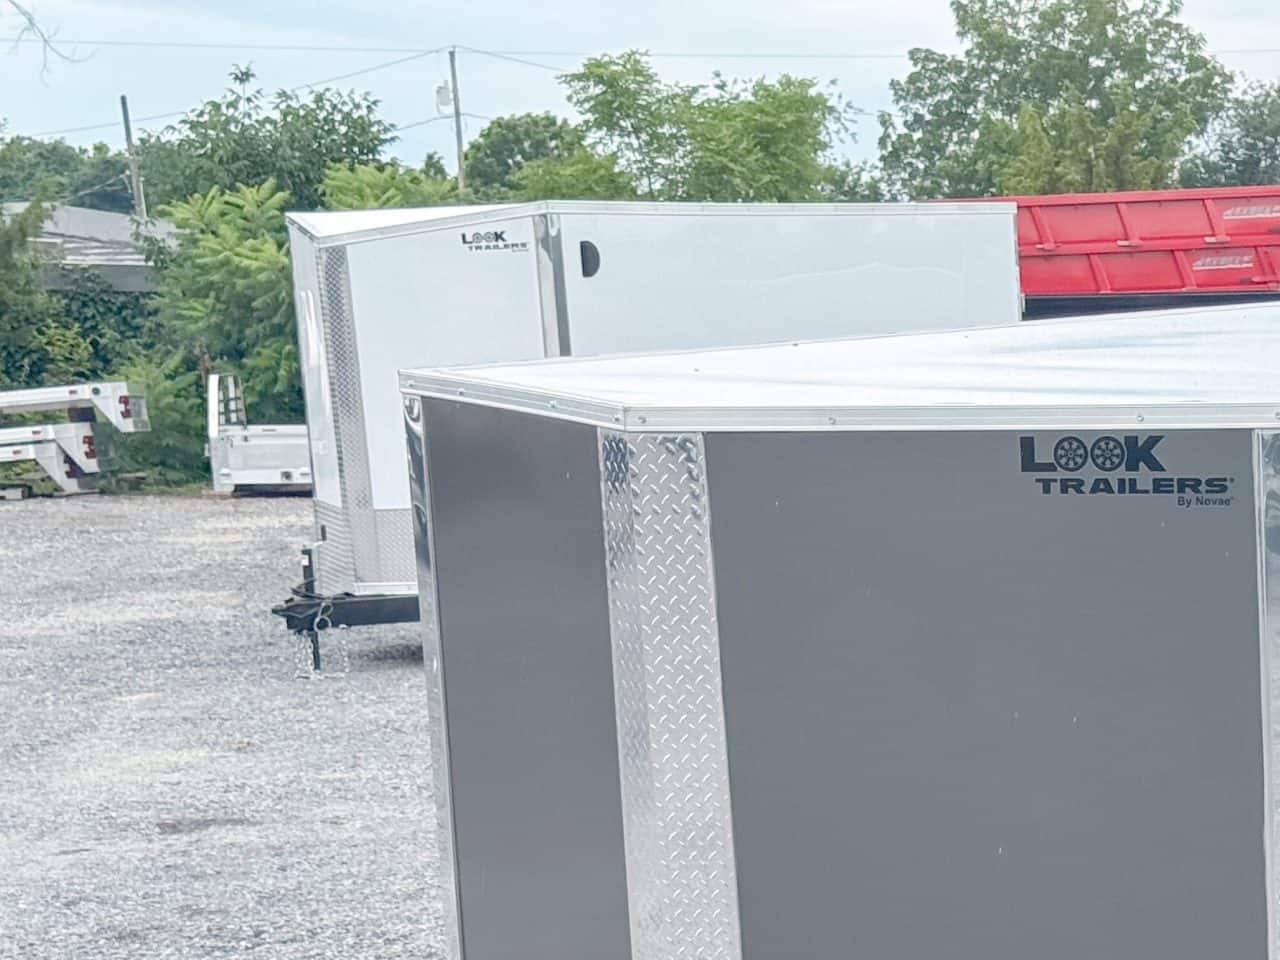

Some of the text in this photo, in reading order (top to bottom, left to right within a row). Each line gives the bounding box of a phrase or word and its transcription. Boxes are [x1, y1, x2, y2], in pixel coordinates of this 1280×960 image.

[461, 231, 507, 245] LOOK
[1019, 435, 1167, 473] LOOK
[1035, 477, 1229, 495] TRAILERS
[1177, 496, 1192, 508] By
